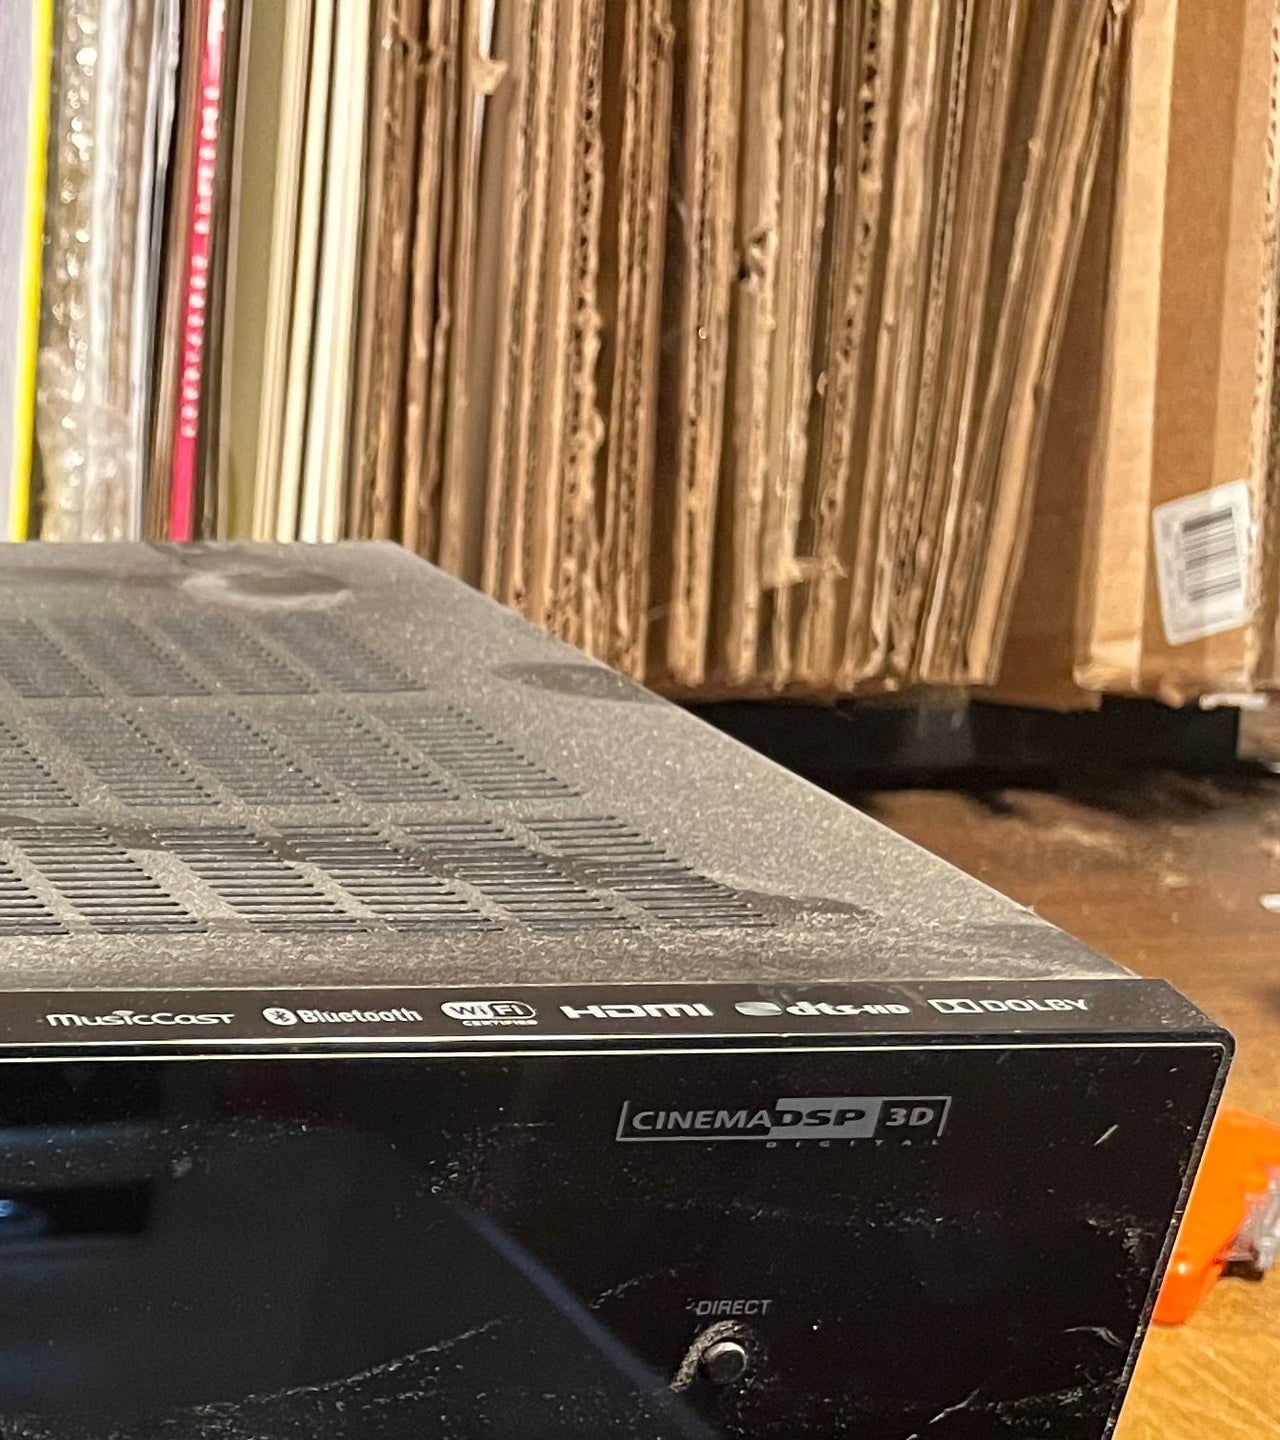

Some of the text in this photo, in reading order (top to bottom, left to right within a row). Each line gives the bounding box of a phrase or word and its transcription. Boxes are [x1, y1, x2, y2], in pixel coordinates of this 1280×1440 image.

[559, 1003, 714, 1019] HDMI
[978, 998, 1090, 1013] DOLBY
[297, 1006, 424, 1025] Bluetooth
[885, 1107, 935, 1127] 3D
[696, 1299, 772, 1316] DIRECT
